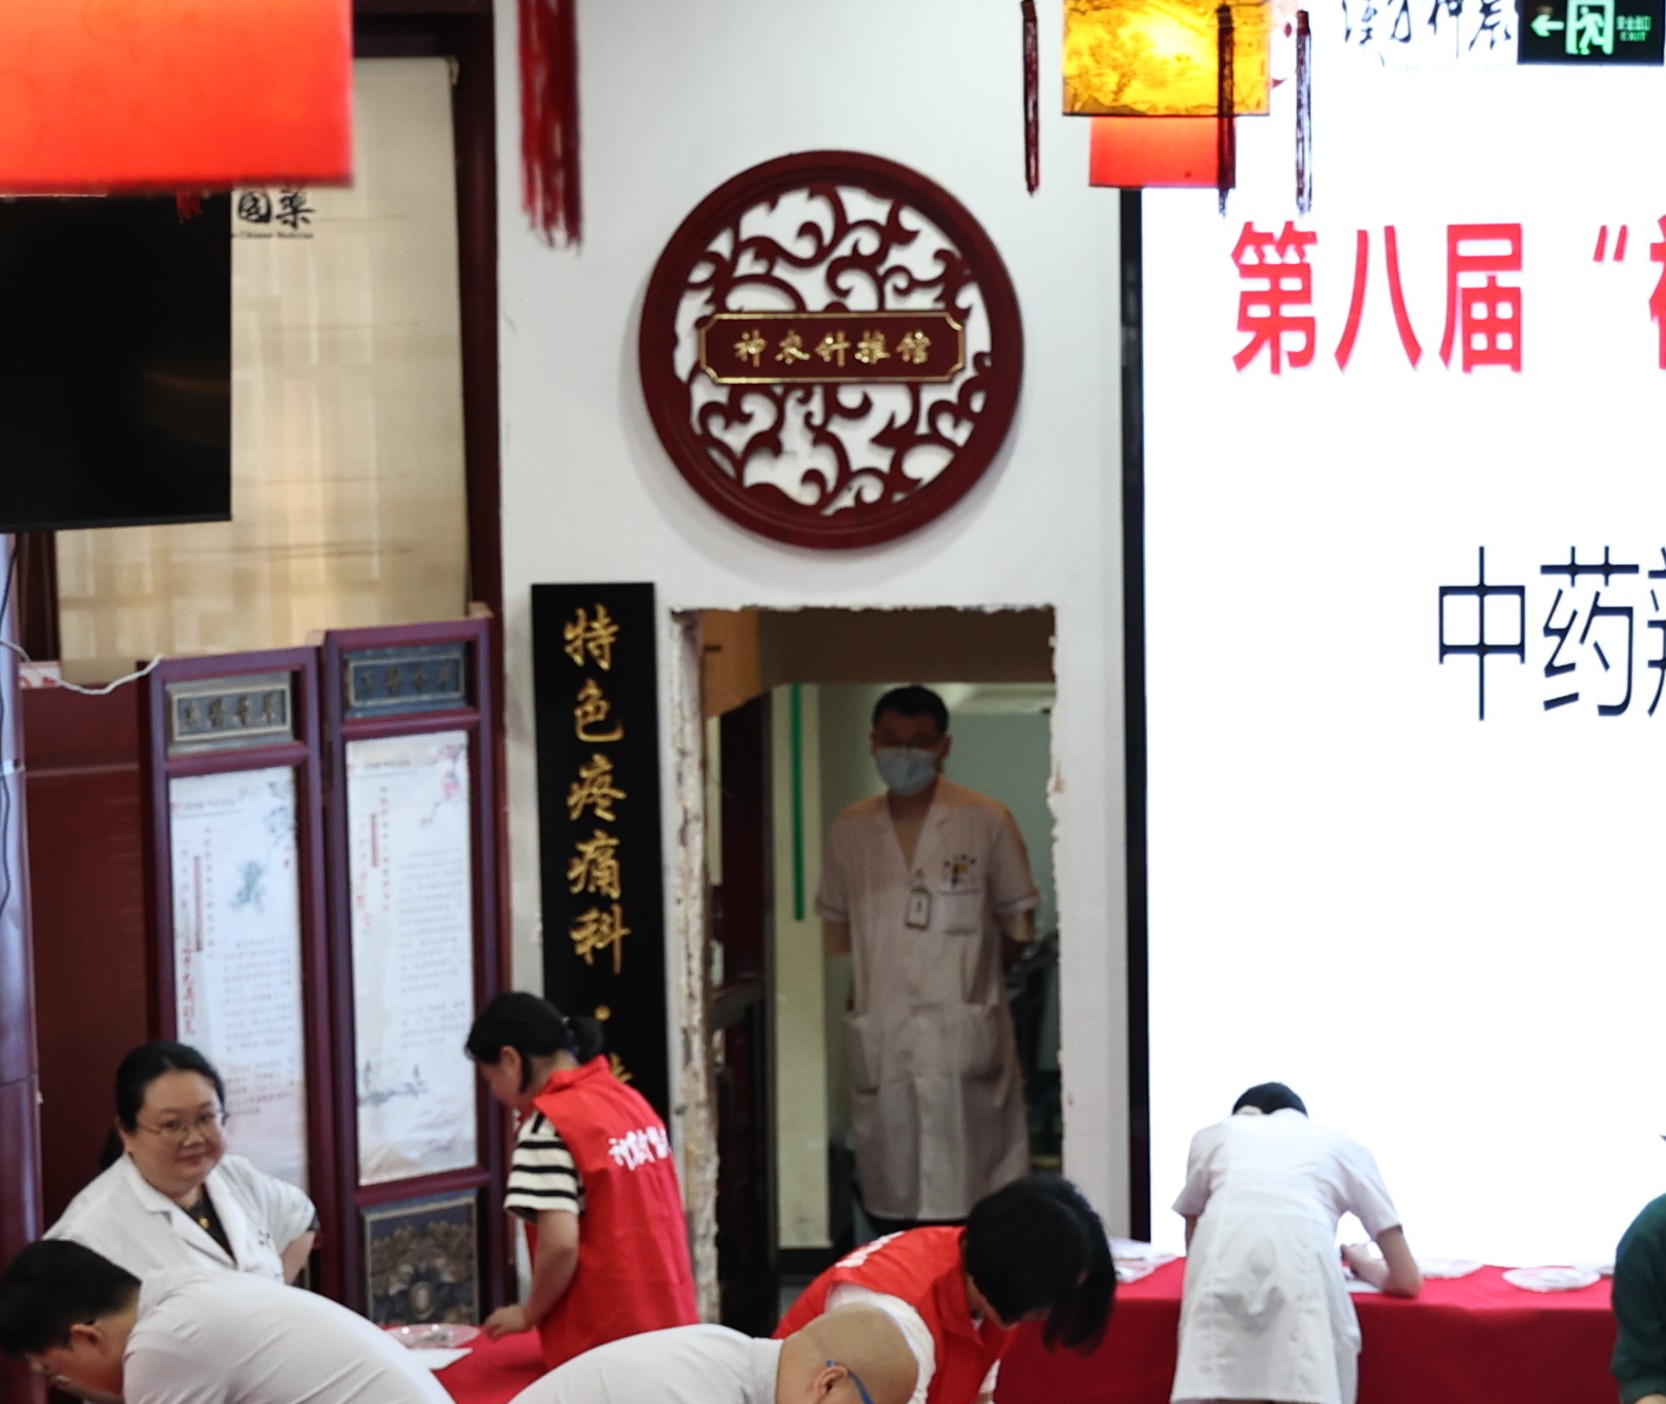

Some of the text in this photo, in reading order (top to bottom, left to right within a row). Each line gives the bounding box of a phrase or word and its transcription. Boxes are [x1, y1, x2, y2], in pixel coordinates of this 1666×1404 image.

[564, 604, 633, 1083] 特色疼痛科·
